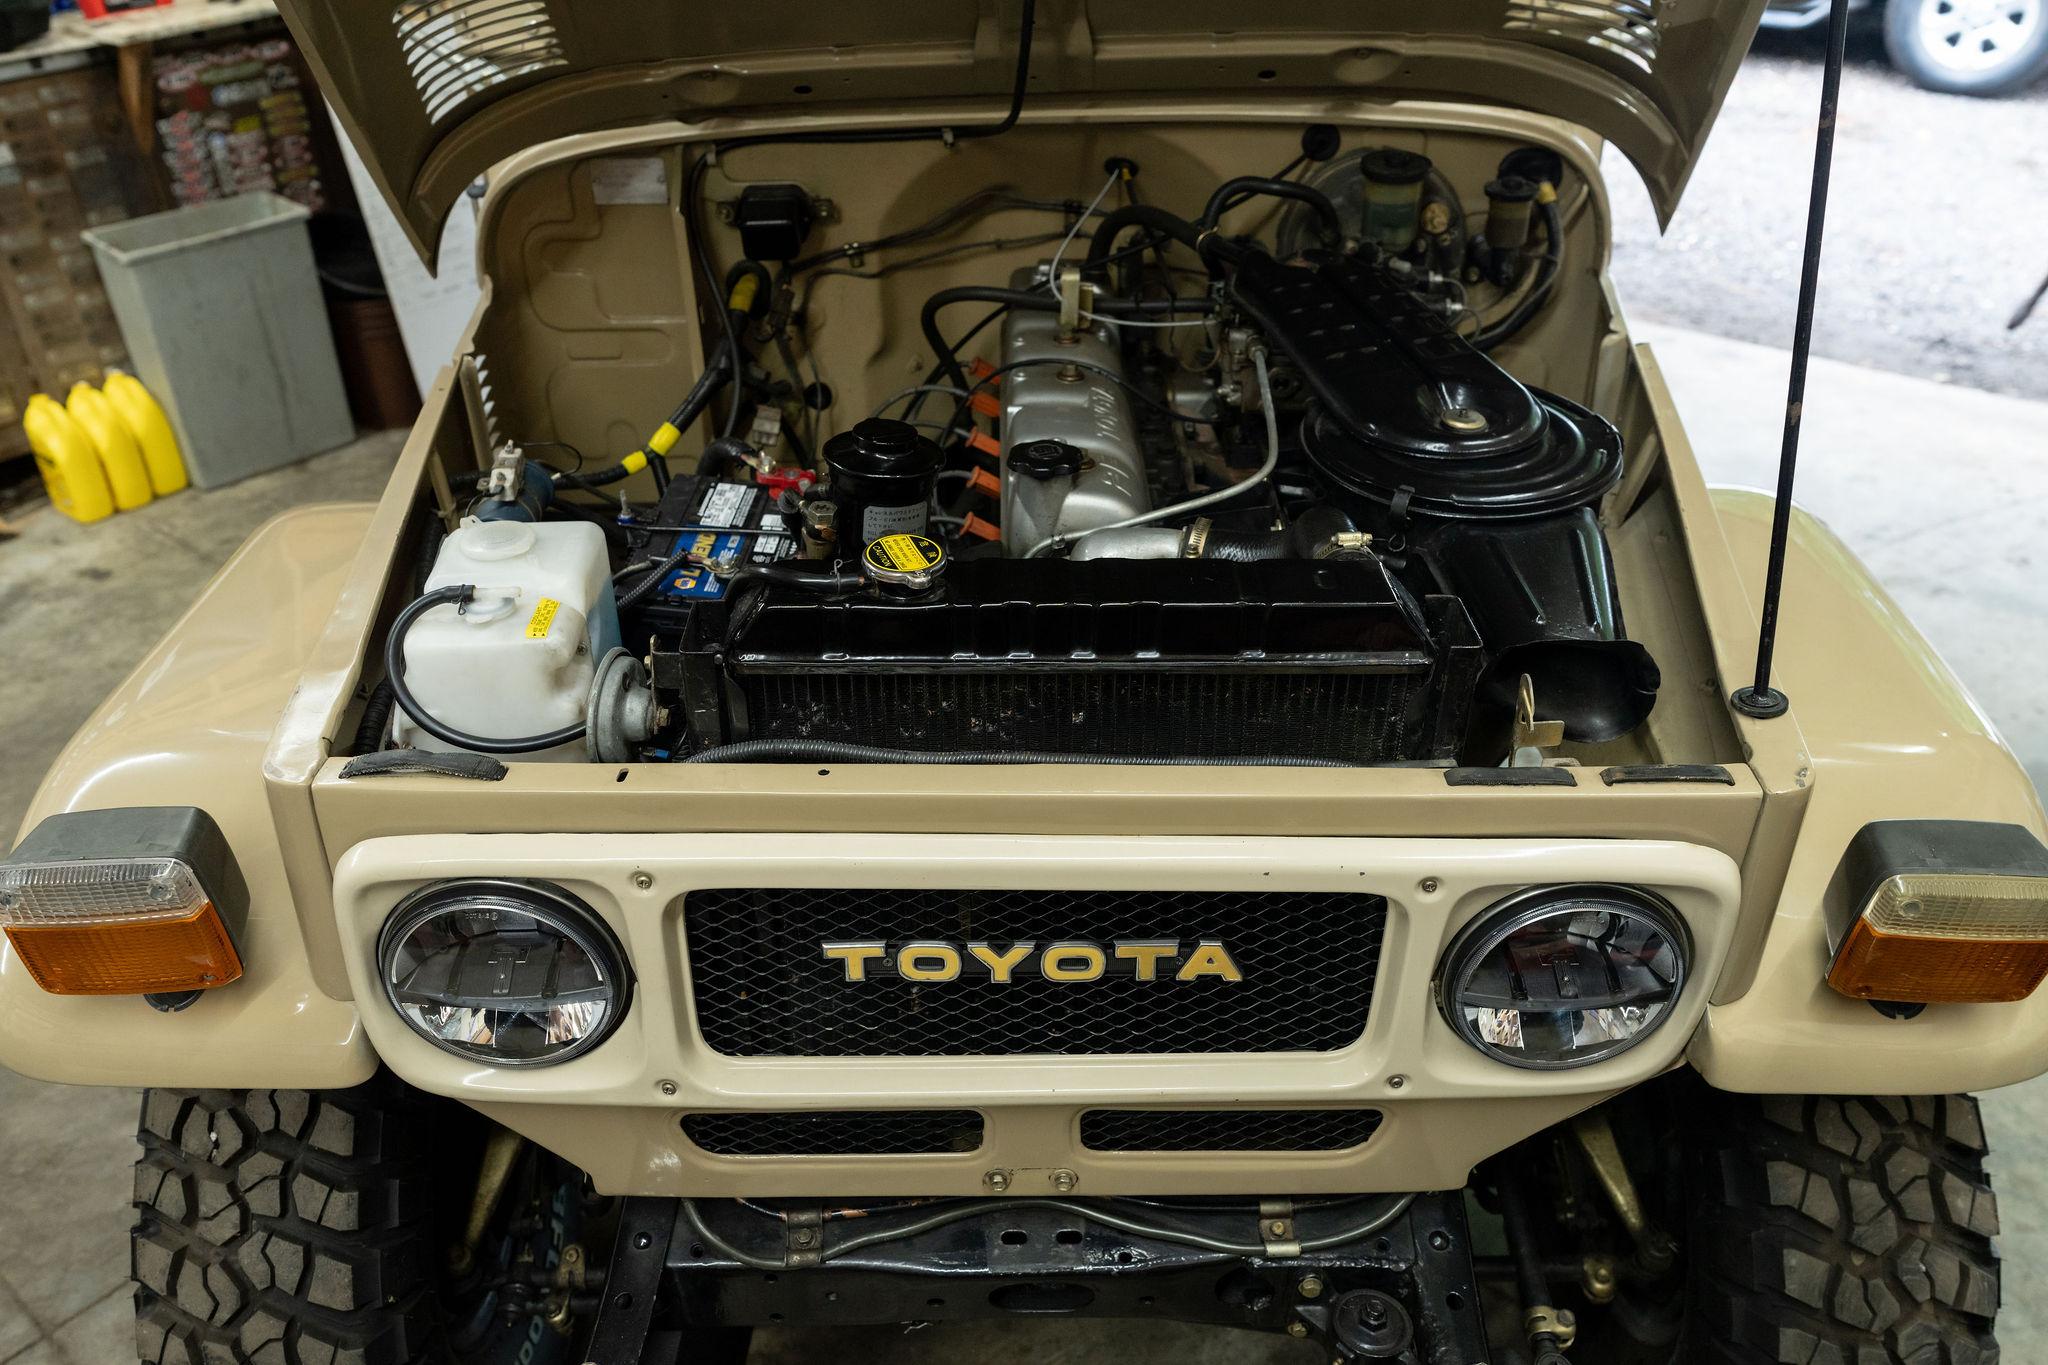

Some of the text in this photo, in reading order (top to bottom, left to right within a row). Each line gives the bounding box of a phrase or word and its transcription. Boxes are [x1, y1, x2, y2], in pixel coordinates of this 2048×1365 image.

[680, 532, 717, 577] LEND
[872, 545, 893, 567] CAUTION
[821, 939, 1244, 983] TOYOTA
